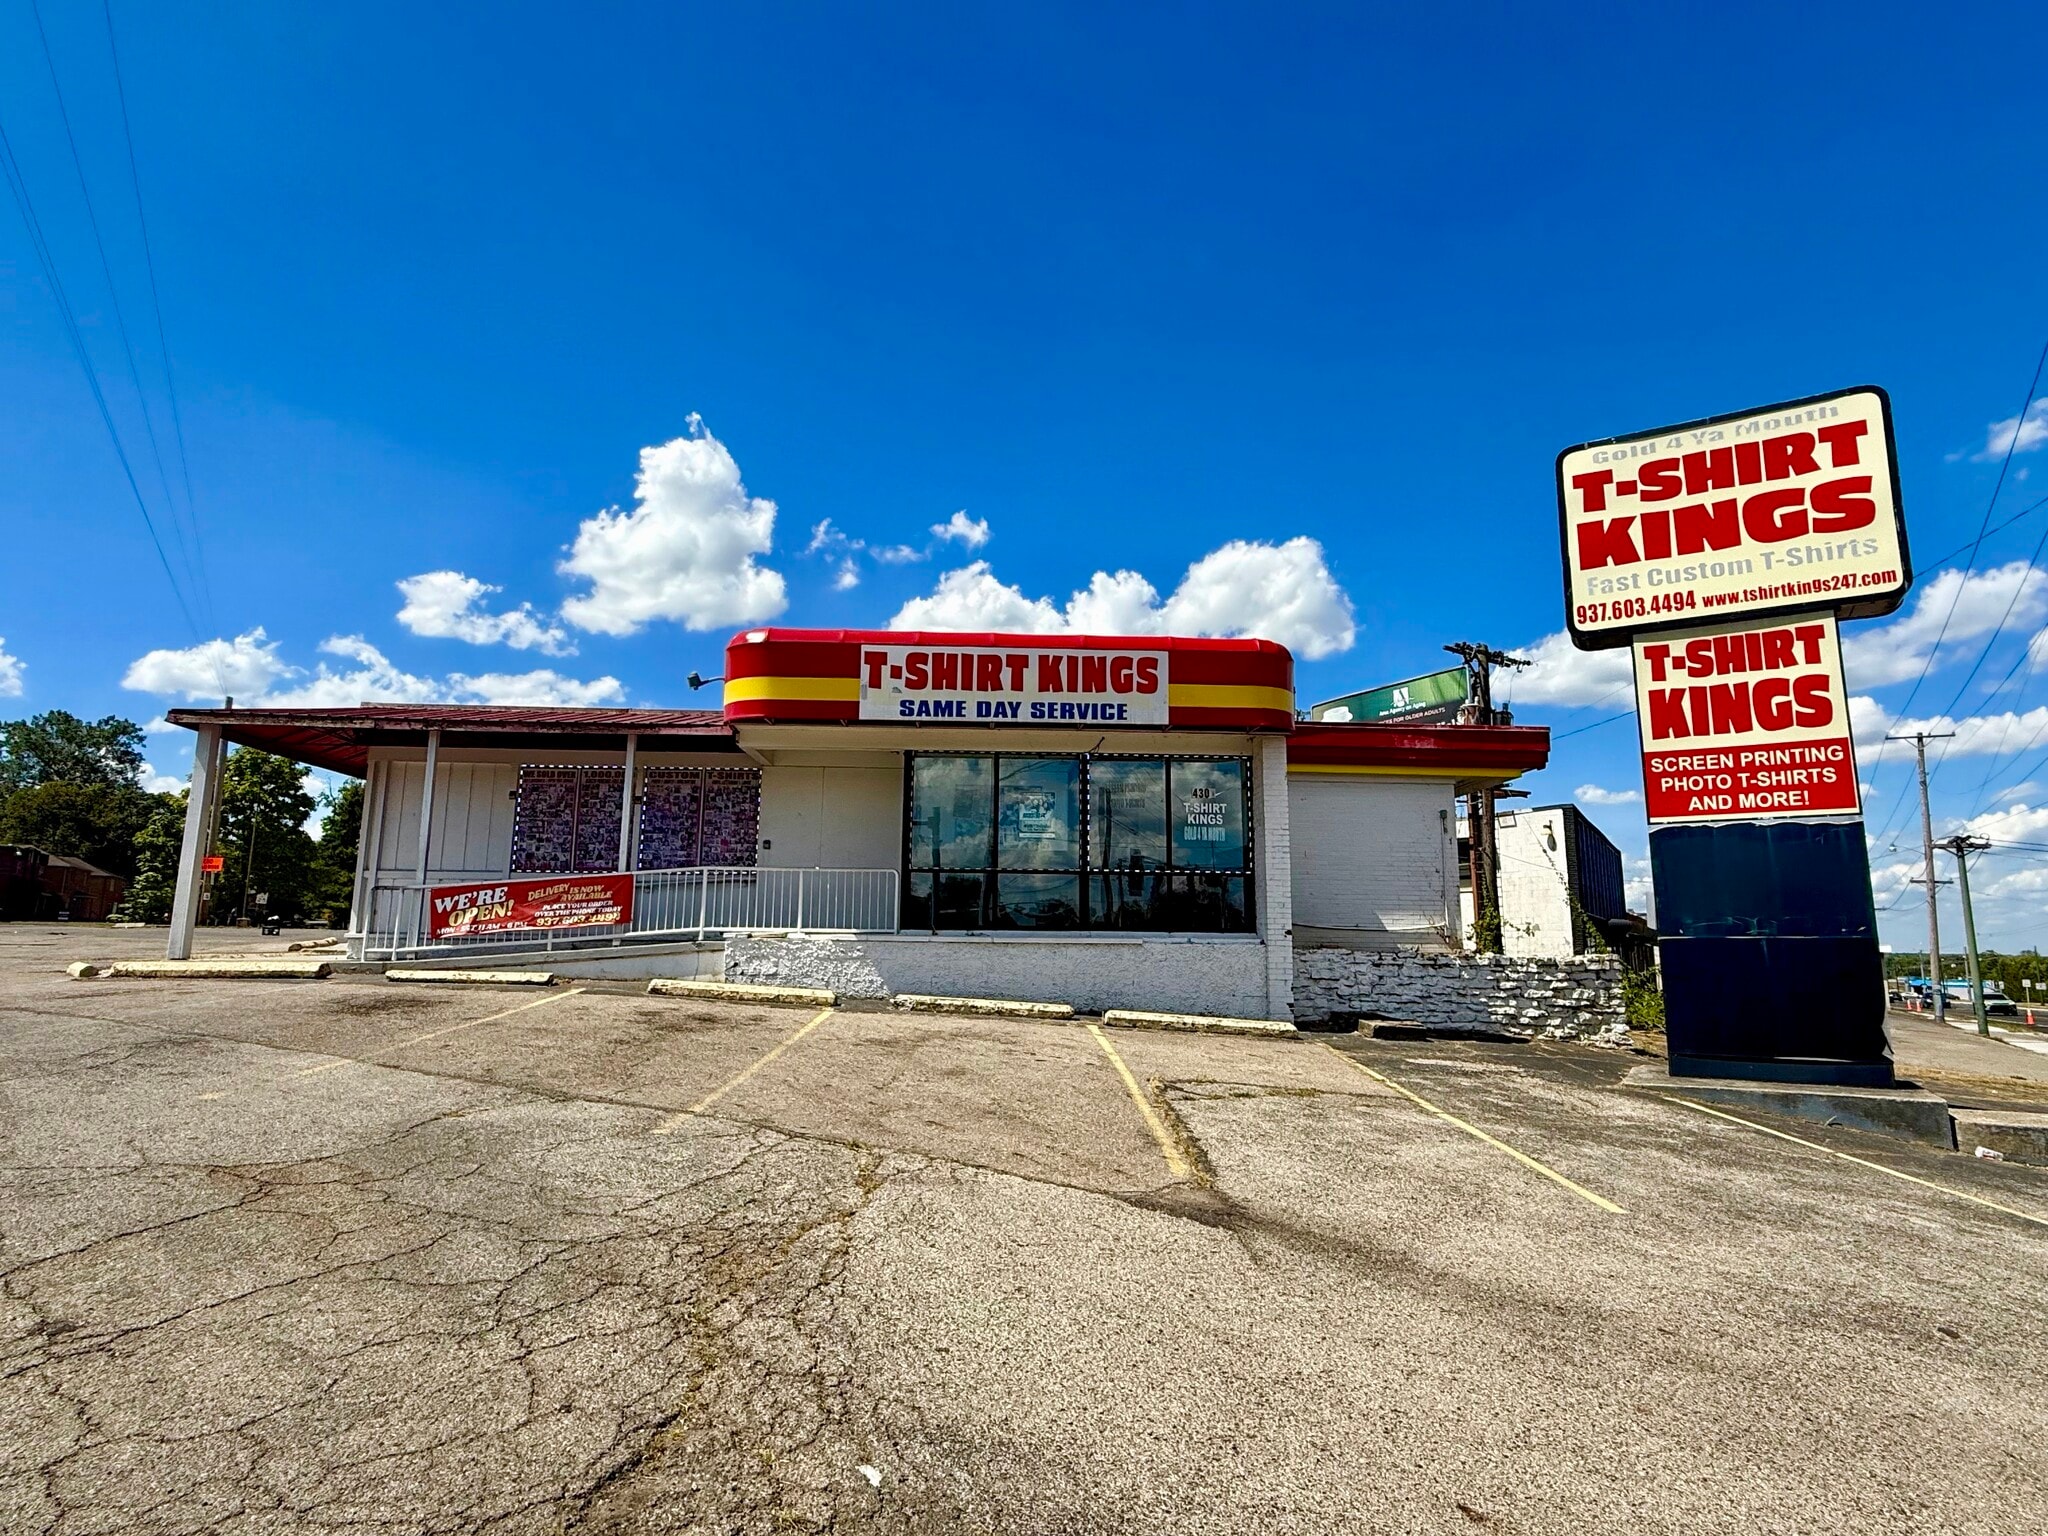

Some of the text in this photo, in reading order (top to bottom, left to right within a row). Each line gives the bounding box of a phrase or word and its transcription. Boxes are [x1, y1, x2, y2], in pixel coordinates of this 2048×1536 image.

[1592, 403, 1840, 465] Gold 4 Ya Mouth
[1572, 419, 1868, 513] T-SHIRT
[1576, 475, 1876, 571] KINGS
[1587, 537, 1879, 596] Fast Custom T-Shirts
[1576, 569, 1897, 624] 937.603.4494 www.tshirtkings247.com
[1643, 624, 1826, 682] T-SHIRT
[863, 650, 1159, 695] T-SHIRT KINGS
[899, 698, 1128, 721] SAME DAY SERVICE
[1648, 673, 1834, 741] KINGS
[1650, 745, 1844, 773] SCREEN PRINTING
[648, 771, 761, 780] CUSTOM T-SHIRTS
[1661, 767, 1837, 792] PHOTO T-SHIRTS
[1192, 788, 1210, 799] 430
[1688, 790, 1810, 811] AND MORE!
[1183, 802, 1227, 814] T-SHIRT
[1187, 813, 1224, 825] KINGS
[434, 886, 508, 914] WE'RE
[528, 883, 604, 901] DELIVERY IS NOW
[449, 900, 515, 927] OPEN!
[542, 903, 566, 911] PLACE
[436, 927, 456, 936] MON
